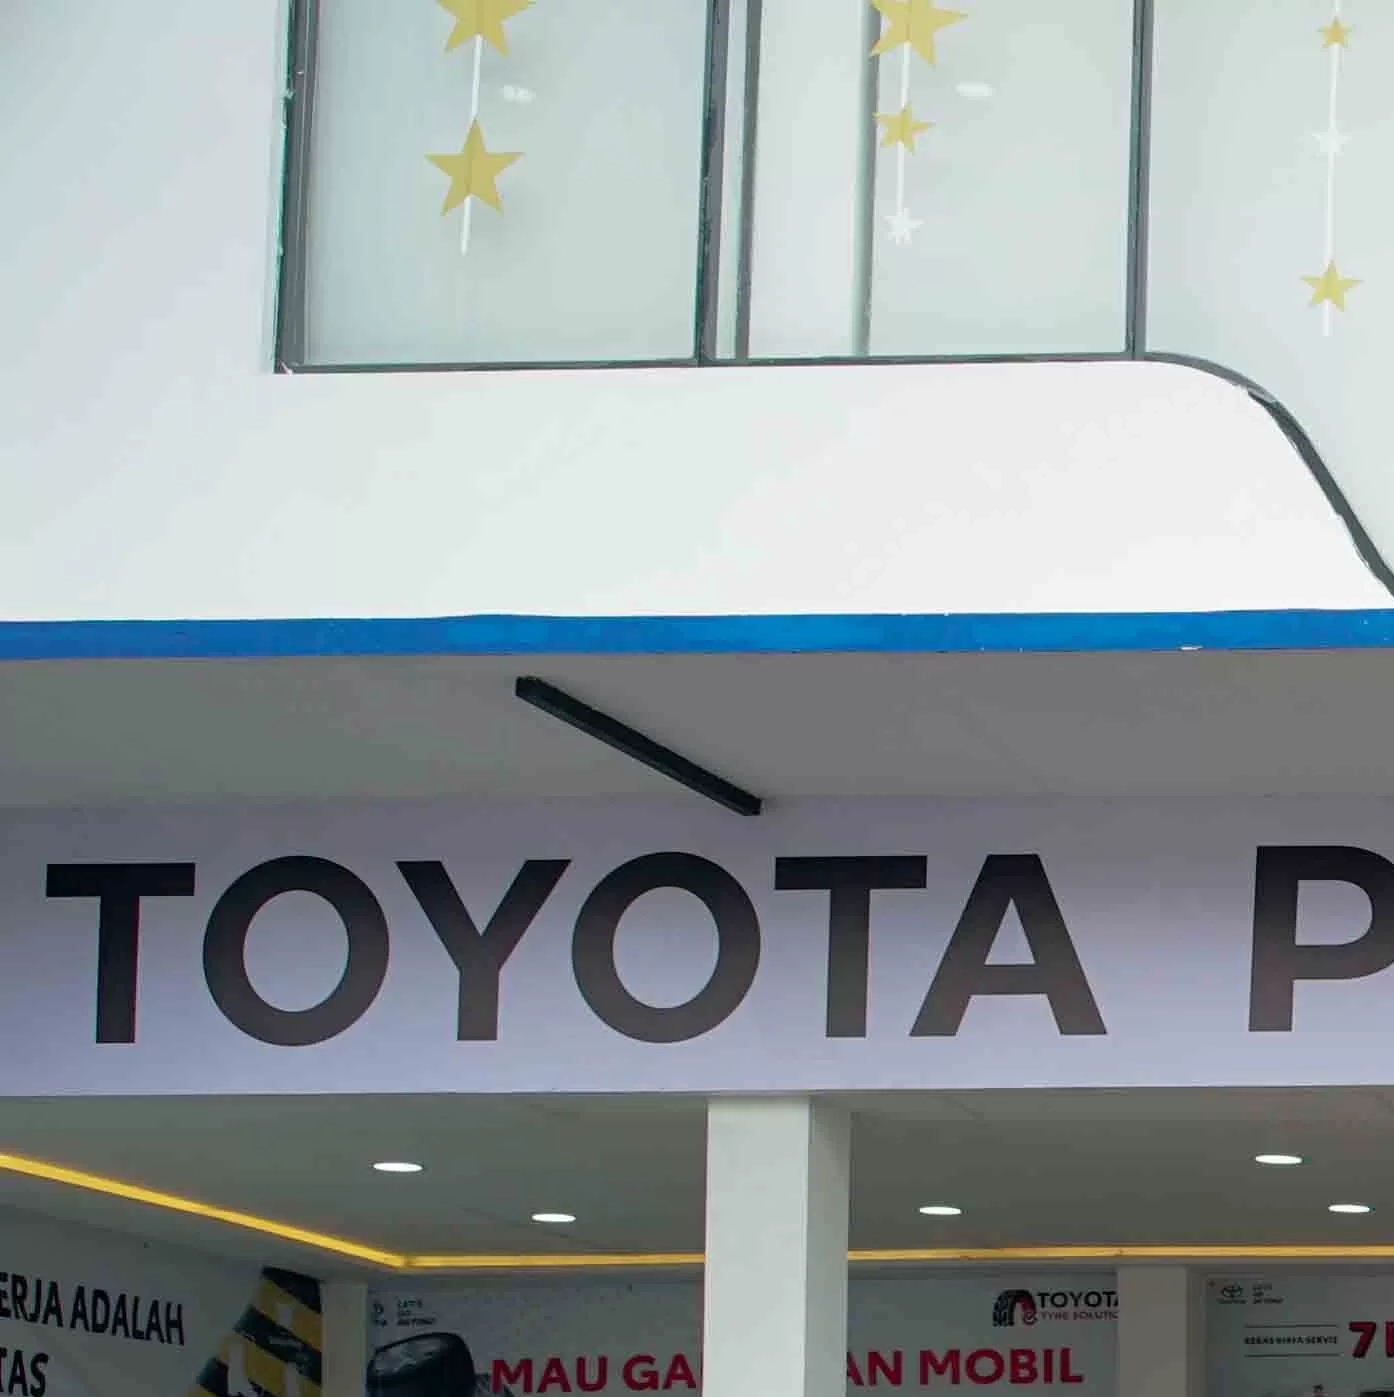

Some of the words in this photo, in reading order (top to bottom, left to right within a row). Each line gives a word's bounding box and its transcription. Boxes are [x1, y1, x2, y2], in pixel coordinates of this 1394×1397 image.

[46, 851, 1107, 1045] TOYOTA
[70, 1285, 184, 1345] ADALAH
[1038, 1291, 1118, 1308] TOYOT
[1348, 1321, 1376, 1358] 7
[491, 1355, 608, 1393] MAU
[919, 1348, 1084, 1384] MOBIL
